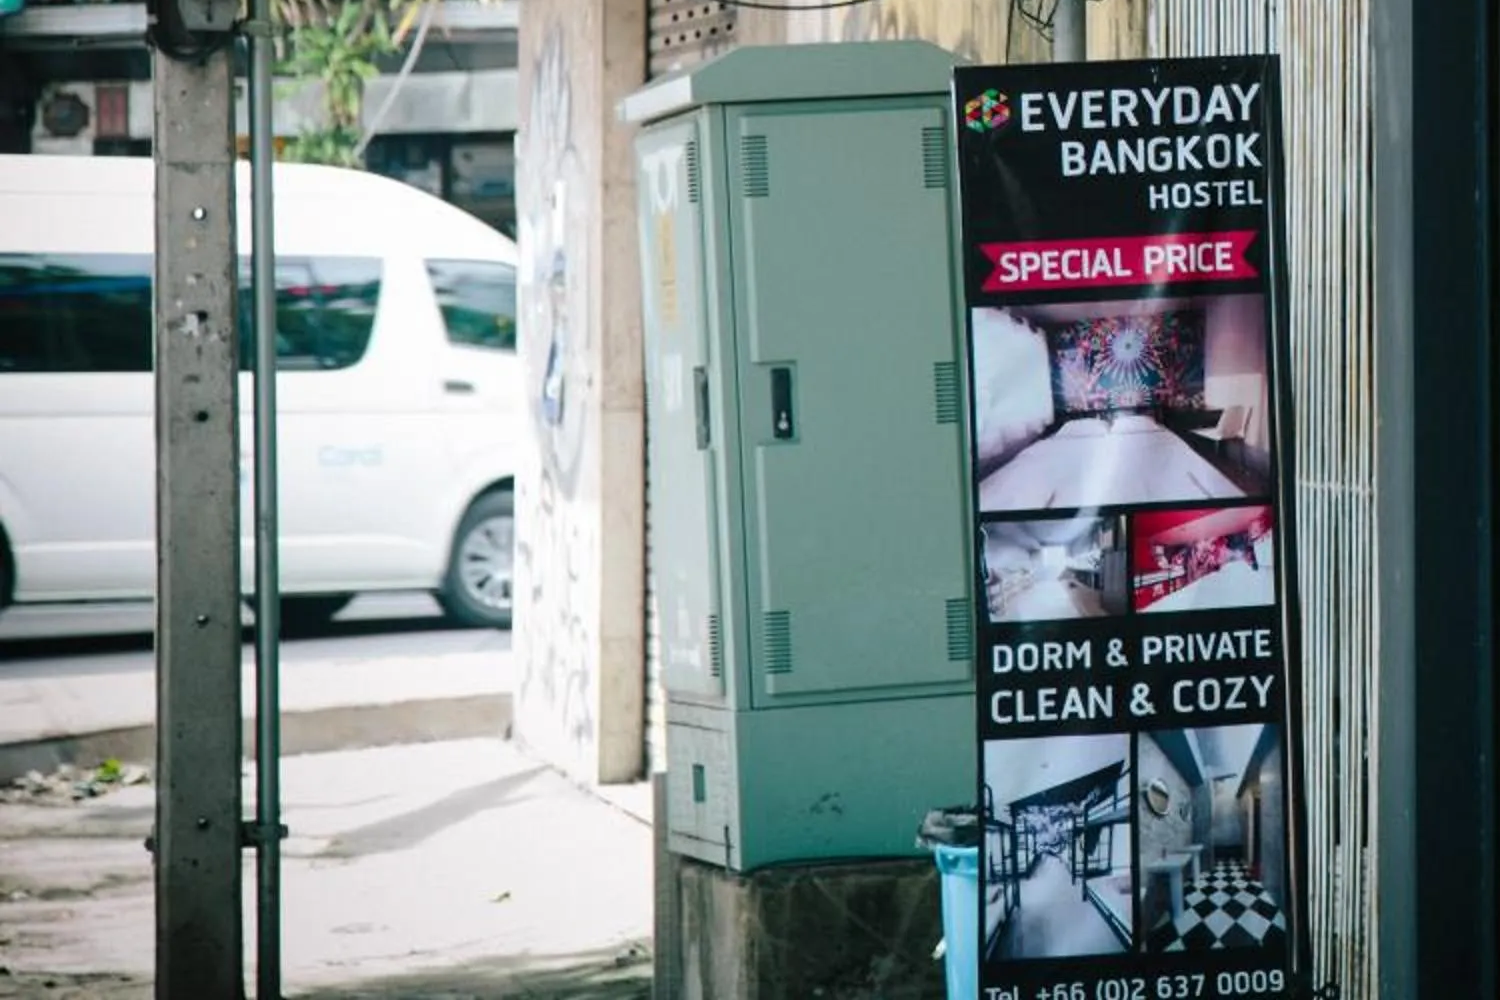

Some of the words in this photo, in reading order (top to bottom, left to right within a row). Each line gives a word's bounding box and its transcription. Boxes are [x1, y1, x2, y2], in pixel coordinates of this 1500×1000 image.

[1021, 82, 1261, 132] EVERYDAY
[1061, 132, 1263, 177] BANGKOK
[1149, 180, 1263, 210] HOSTEL
[999, 249, 1132, 284] SPECIAL
[1143, 241, 1234, 275] PRICE
[992, 640, 1091, 673] DORM
[1105, 637, 1128, 667] &
[1142, 629, 1272, 665] PRIVATE
[990, 686, 1114, 724] CLEAN
[1129, 683, 1155, 716] &
[1172, 675, 1275, 714] COZY
[1035, 981, 1085, 1000] +66
[1095, 977, 1146, 1000] (0)2
[1156, 973, 1206, 997] 637
[1217, 969, 1285, 995] 0009
